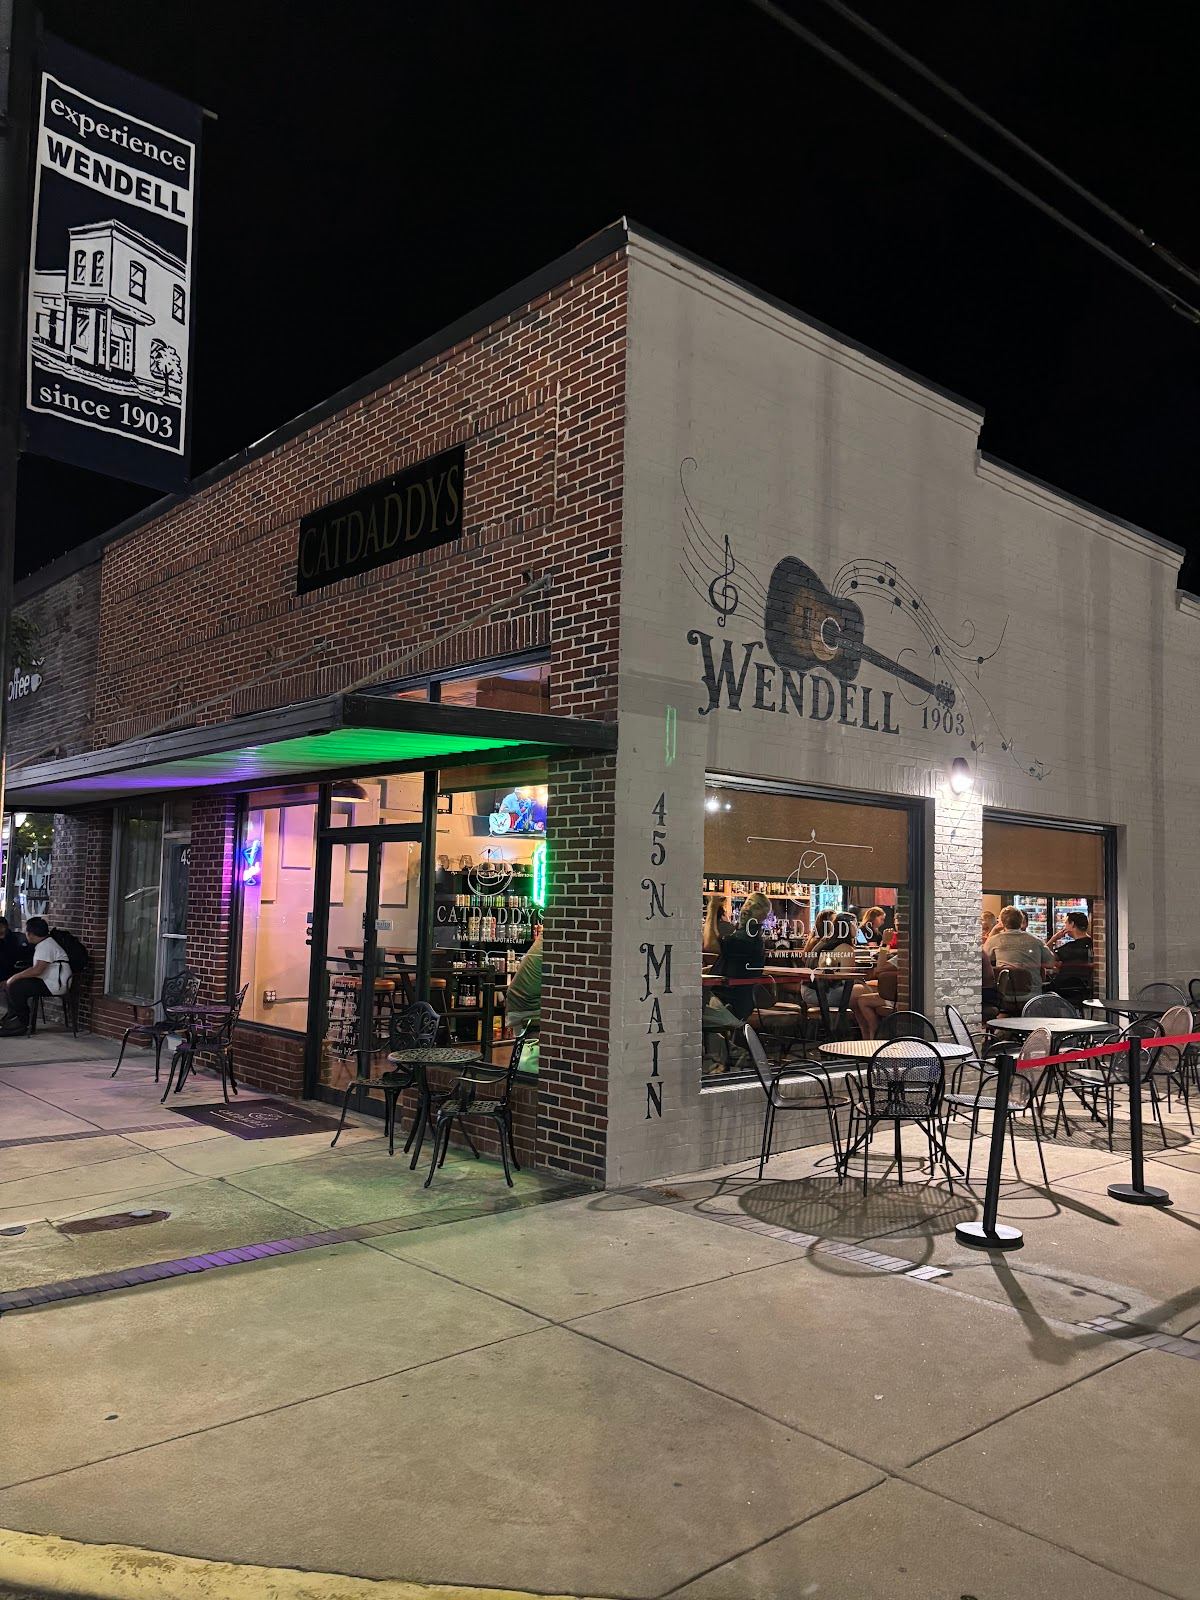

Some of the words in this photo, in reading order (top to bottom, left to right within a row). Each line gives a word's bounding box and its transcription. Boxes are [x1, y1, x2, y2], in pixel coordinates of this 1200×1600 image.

[50, 96, 187, 172] experience
[47, 135, 187, 218] WENDELL
[39, 383, 111, 421] since
[120, 401, 173, 439] 1903
[300, 464, 459, 579] CATDADDYS
[921, 705, 966, 736] 1903
[640, 878, 674, 921] N
[745, 917, 874, 940] CATDADDYS
[639, 942, 674, 1120] MAIN
